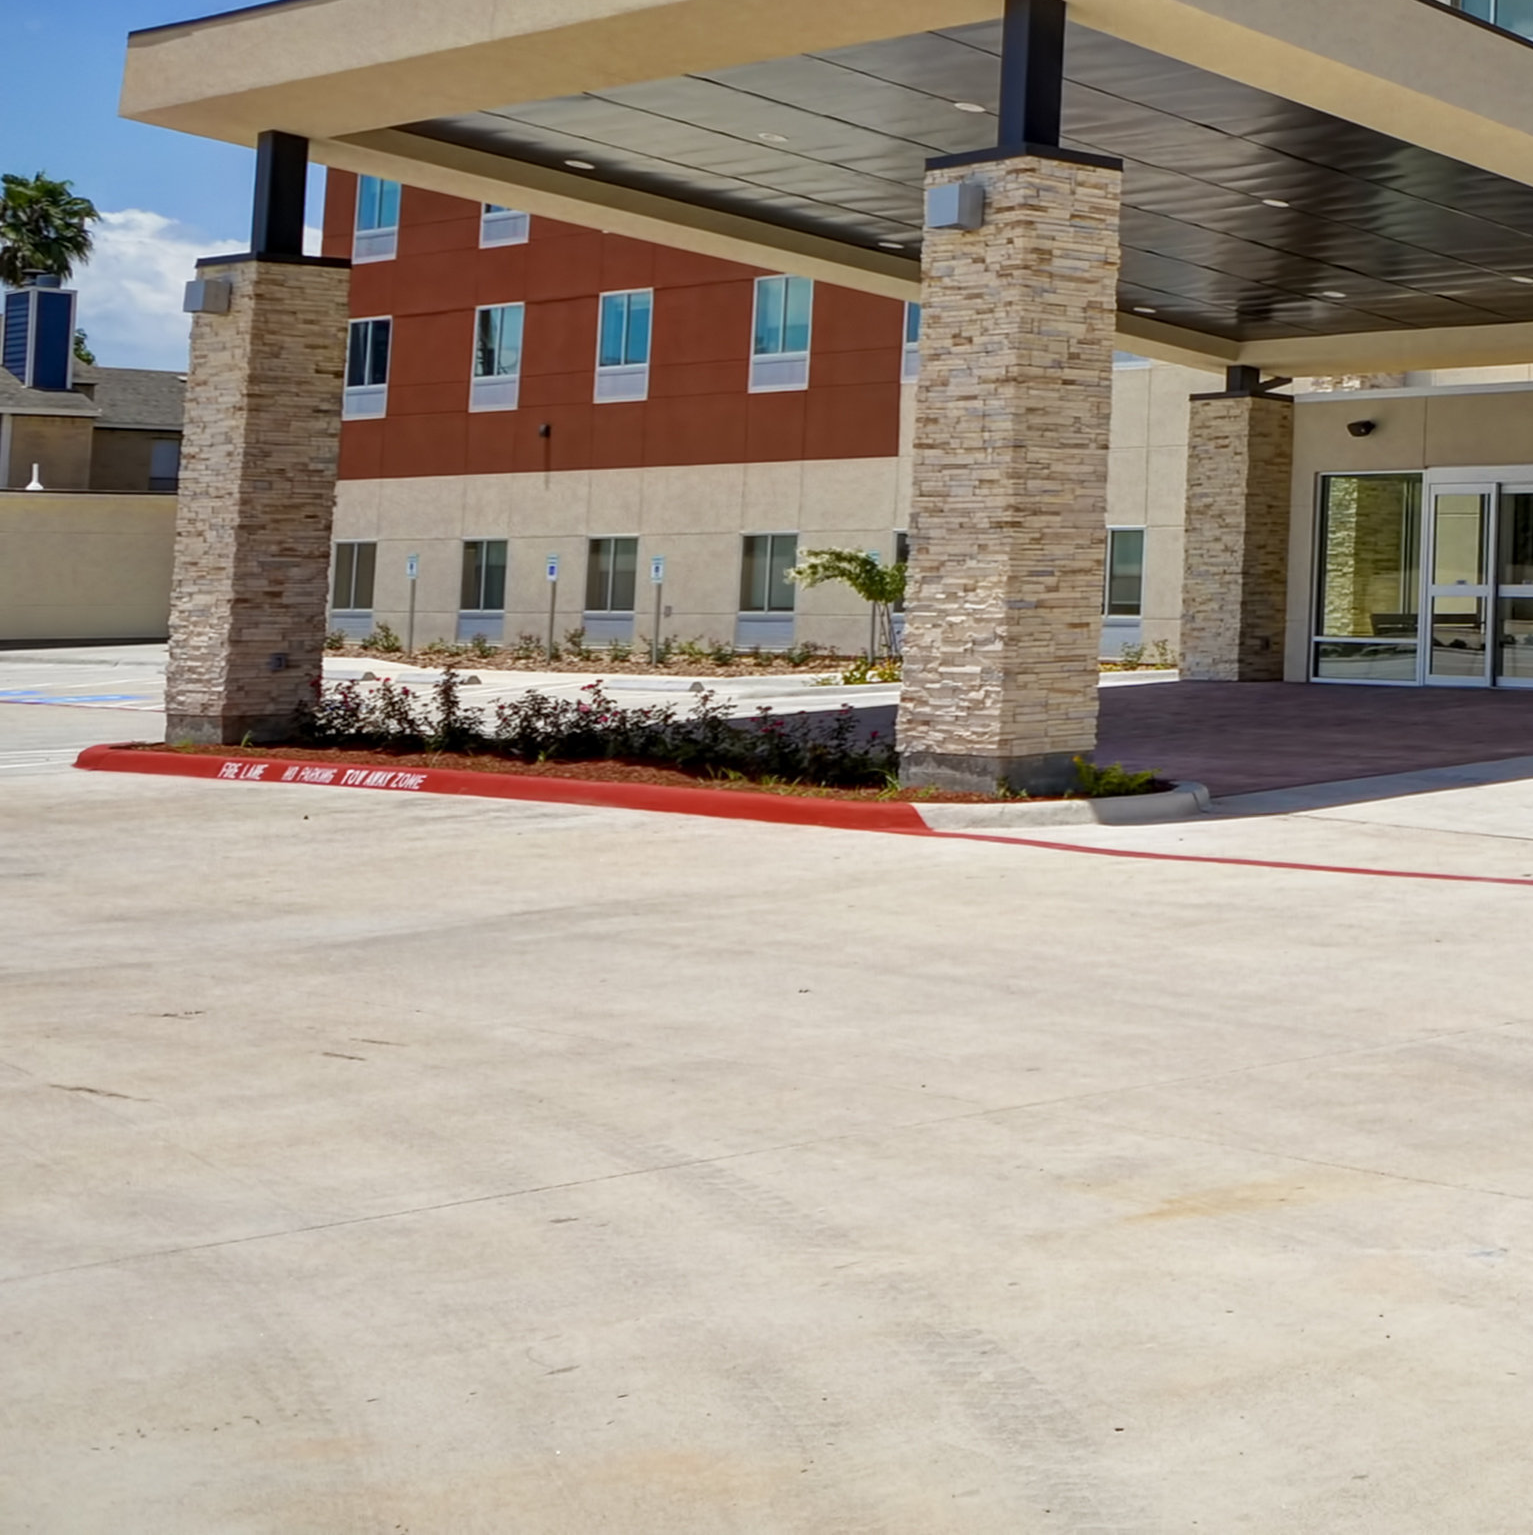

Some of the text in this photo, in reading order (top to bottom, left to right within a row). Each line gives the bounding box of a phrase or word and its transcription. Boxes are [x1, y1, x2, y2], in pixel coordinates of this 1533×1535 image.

[217, 762, 243, 779] FIRE
[239, 764, 269, 780] LANE
[295, 766, 338, 784] PARKING
[340, 769, 370, 785] TOW
[362, 770, 396, 787] AWAY
[389, 772, 428, 790] ZONE
